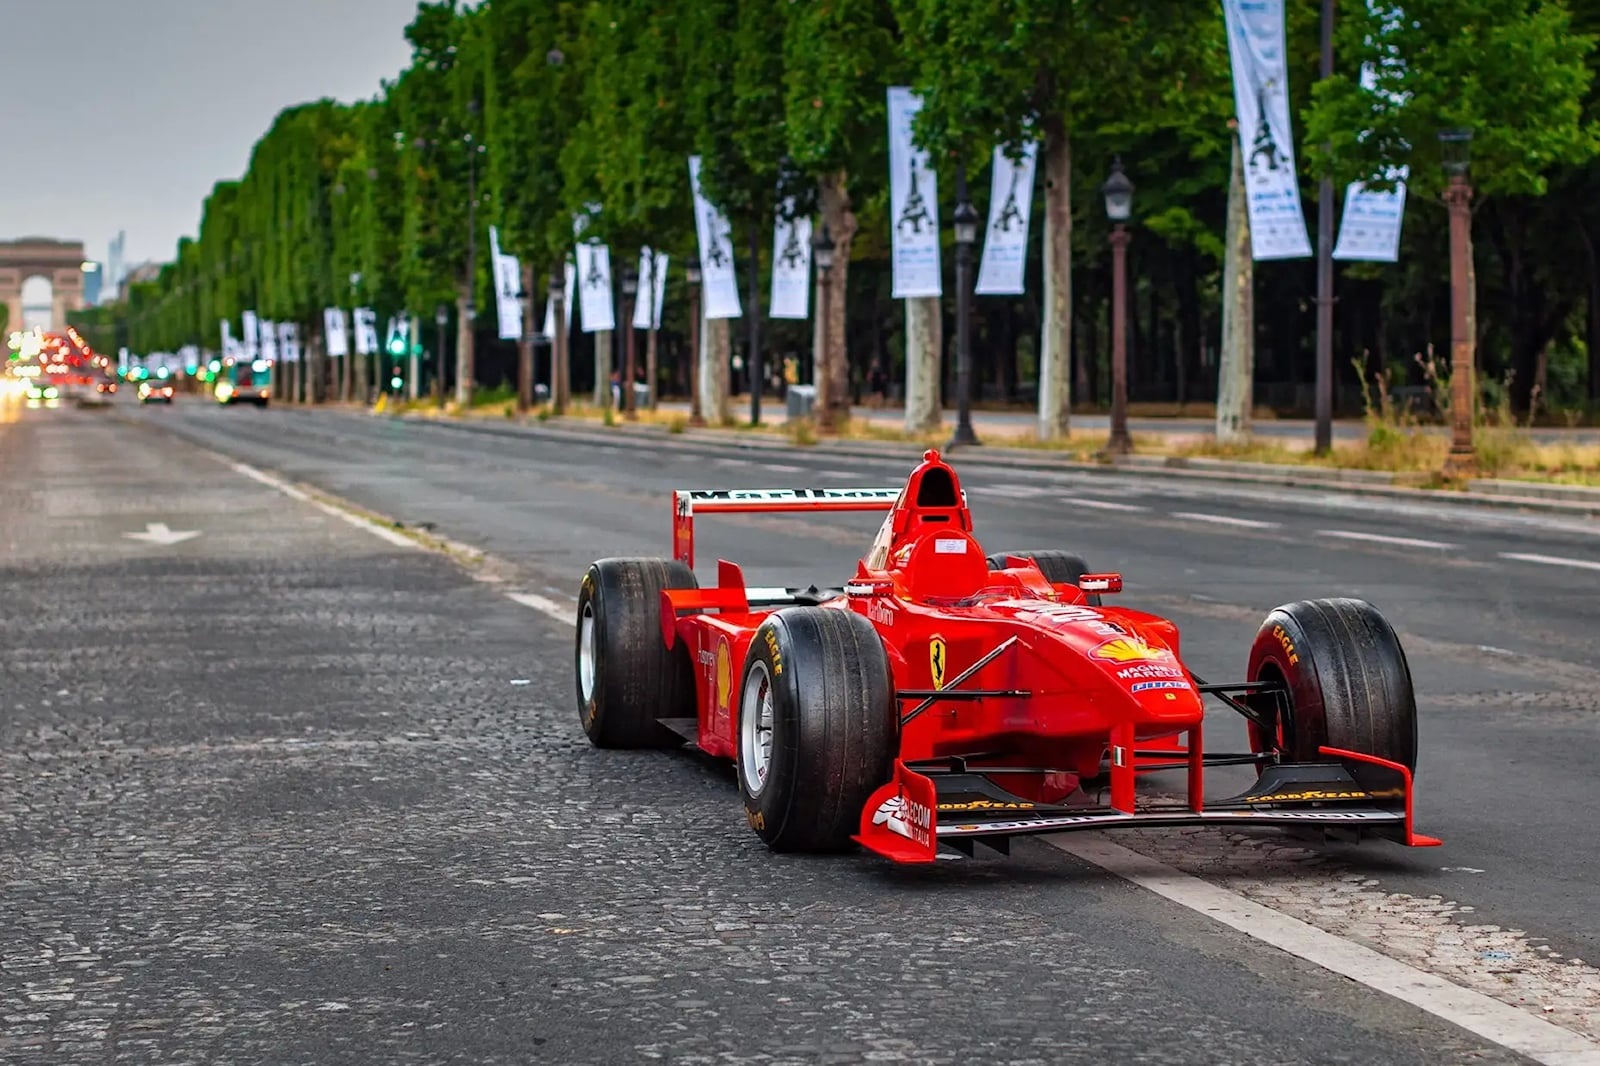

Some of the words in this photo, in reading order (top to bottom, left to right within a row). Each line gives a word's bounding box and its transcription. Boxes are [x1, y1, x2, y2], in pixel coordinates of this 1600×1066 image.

[690, 489, 898, 499] Marlbor
[764, 629, 783, 677] EAGLE
[1272, 625, 1299, 666] EAGLE
[936, 800, 1035, 810] ODYEAR
